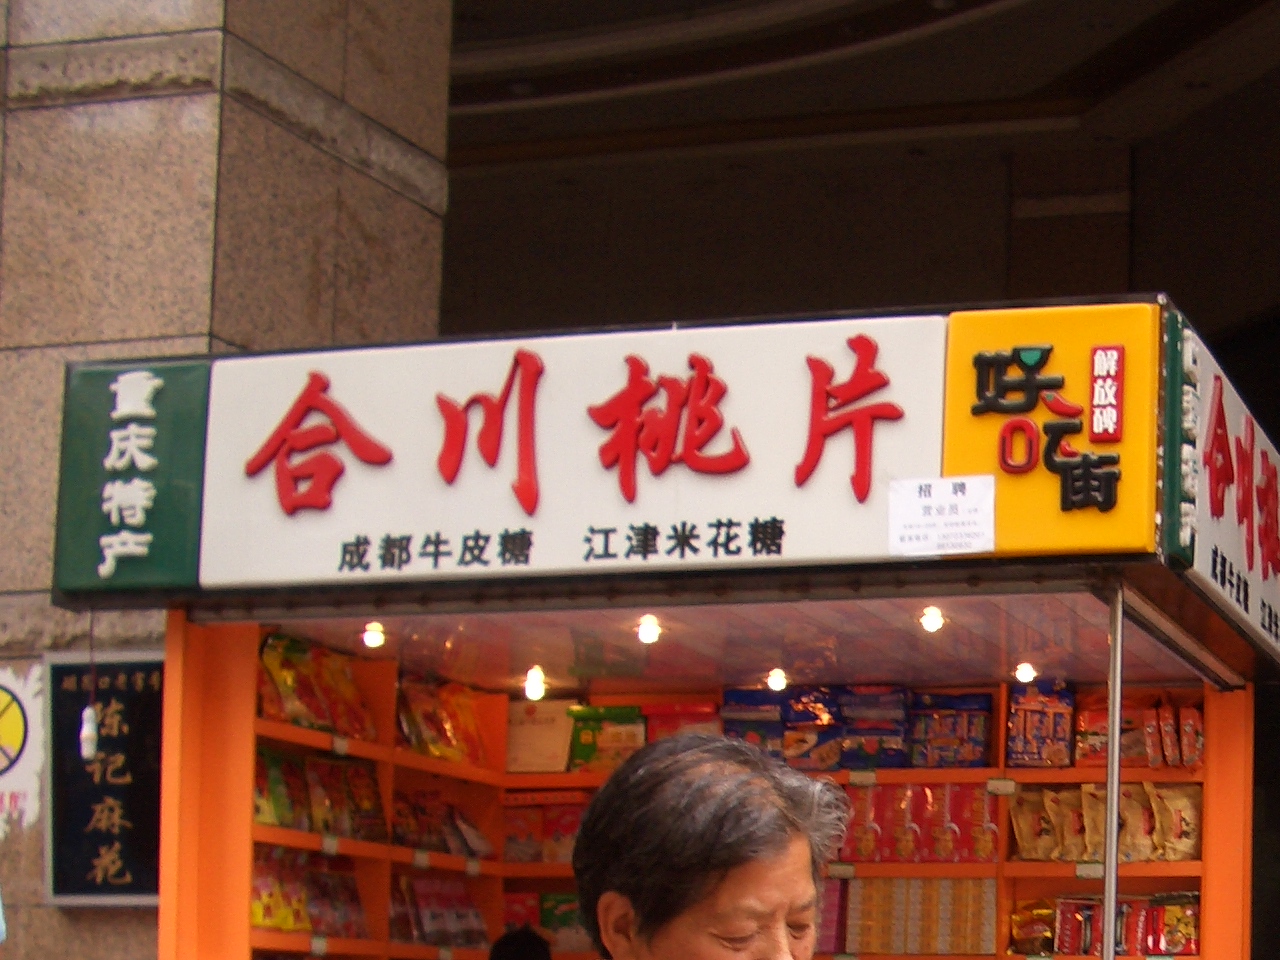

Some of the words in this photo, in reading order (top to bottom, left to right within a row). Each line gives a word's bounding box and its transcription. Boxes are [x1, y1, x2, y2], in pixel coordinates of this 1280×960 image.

[97, 369, 165, 579] 重庆特产
[244, 333, 904, 517] 合川桃片
[338, 528, 534, 574] 成都牛皮糖
[582, 515, 787, 562] 江津米花糖
